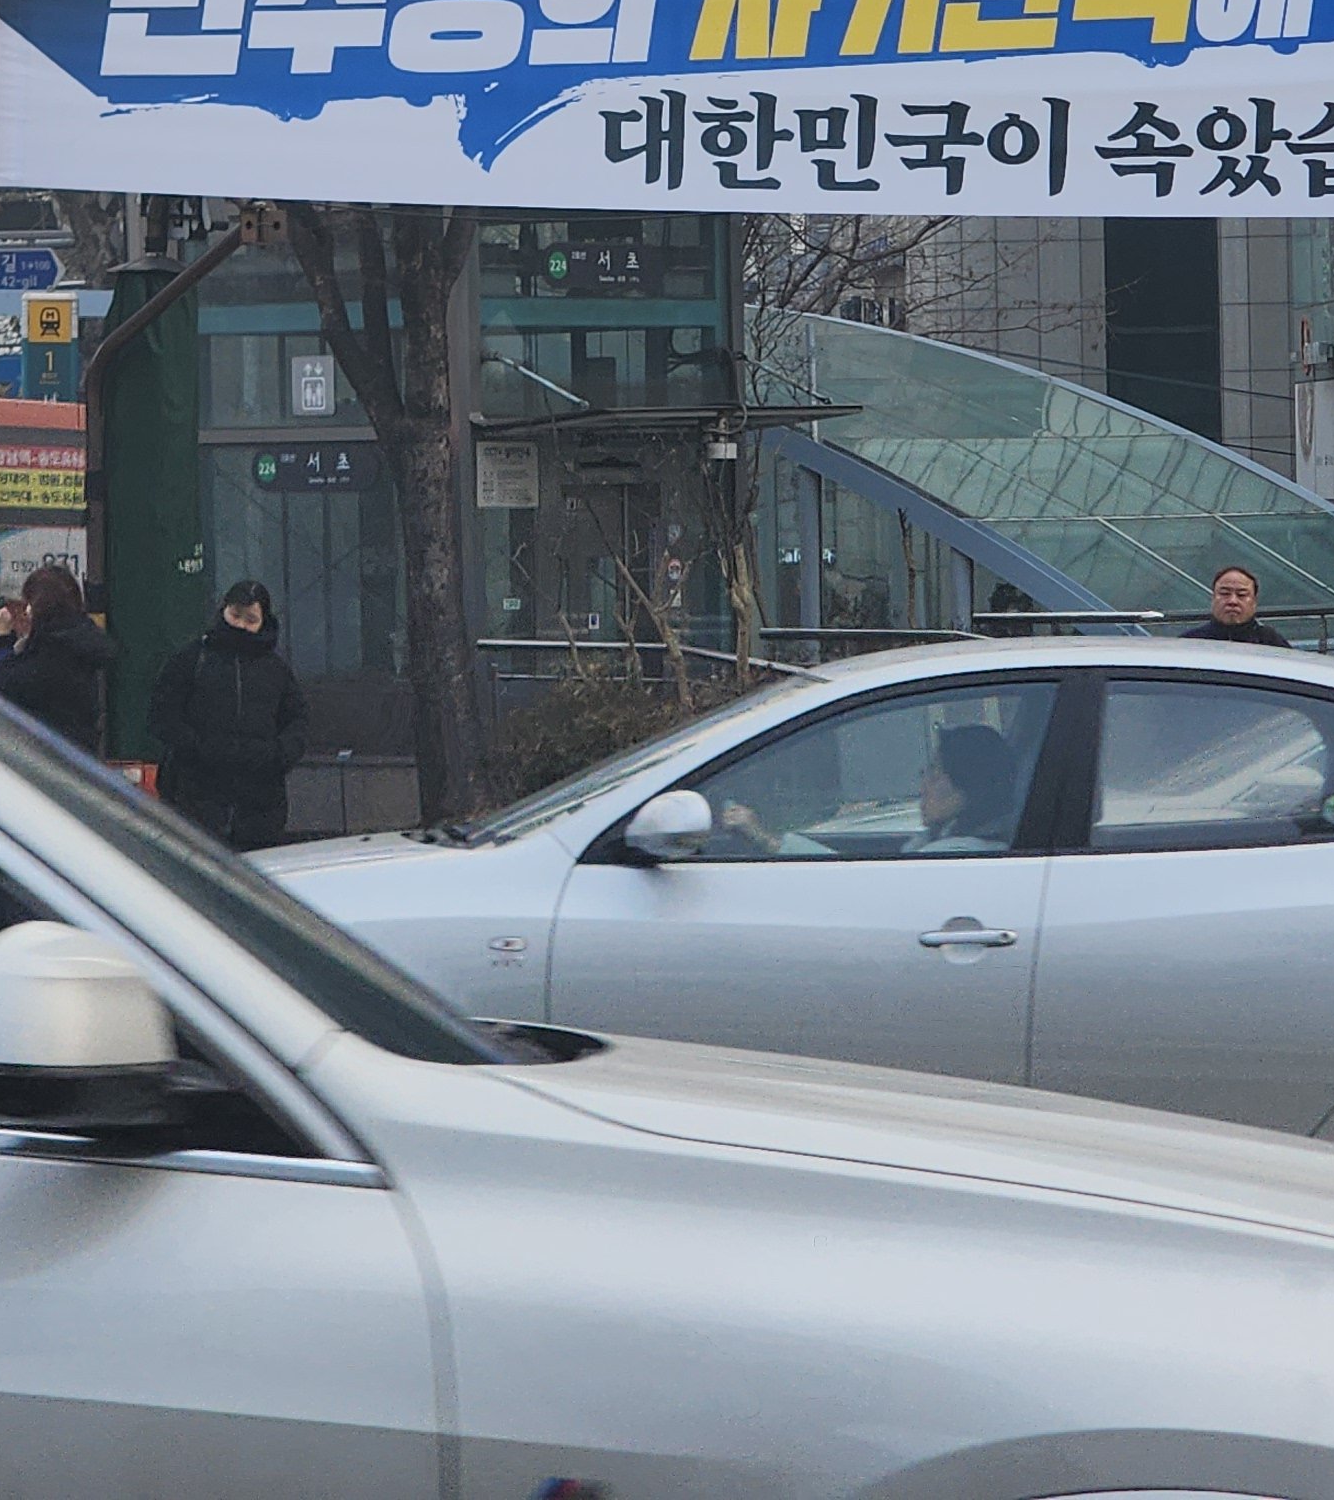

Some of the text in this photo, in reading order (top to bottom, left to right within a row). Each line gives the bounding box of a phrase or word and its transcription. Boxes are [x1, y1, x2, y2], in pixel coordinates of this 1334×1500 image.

[602, 88, 1072, 198] 대한민국이
[549, 260, 567, 272] 224
[0, 275, 39, 290] 42-gil
[44, 350, 53, 371] 1
[258, 462, 277, 475] 224
